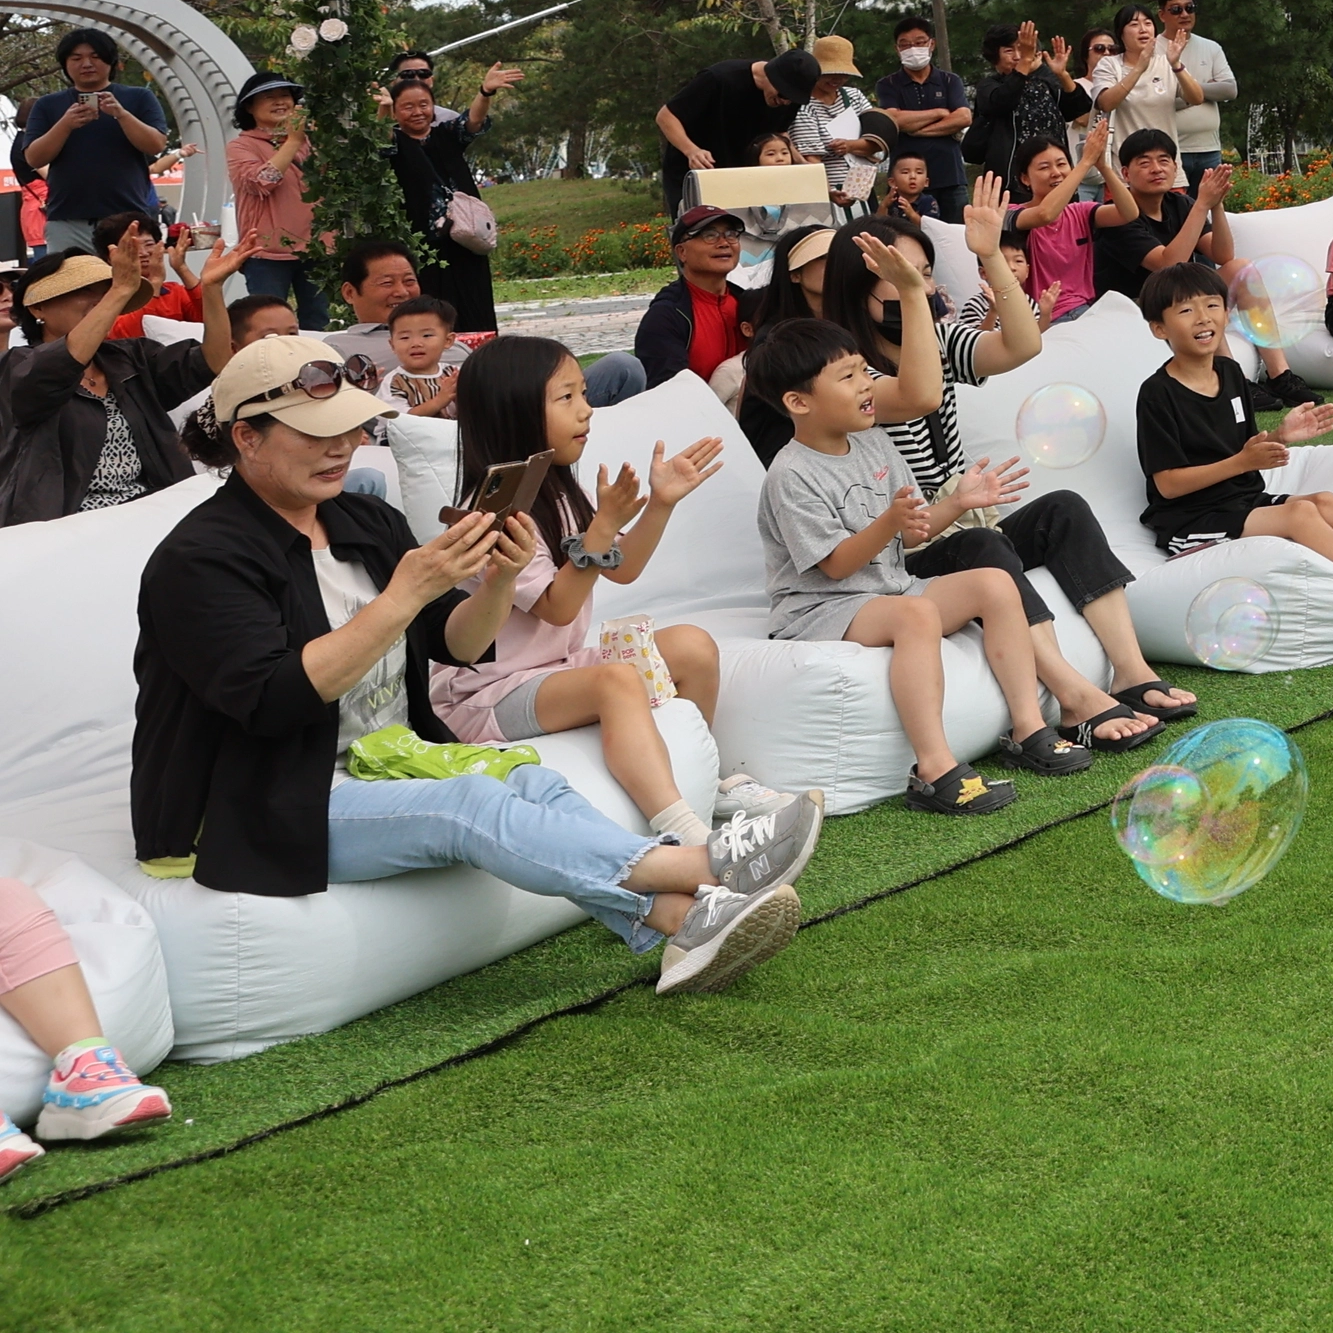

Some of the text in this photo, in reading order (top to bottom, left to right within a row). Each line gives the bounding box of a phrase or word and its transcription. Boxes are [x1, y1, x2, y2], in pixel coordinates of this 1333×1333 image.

[749, 853, 771, 881] N
[702, 904, 725, 929] N
[43, 1092, 100, 1108] ILA
